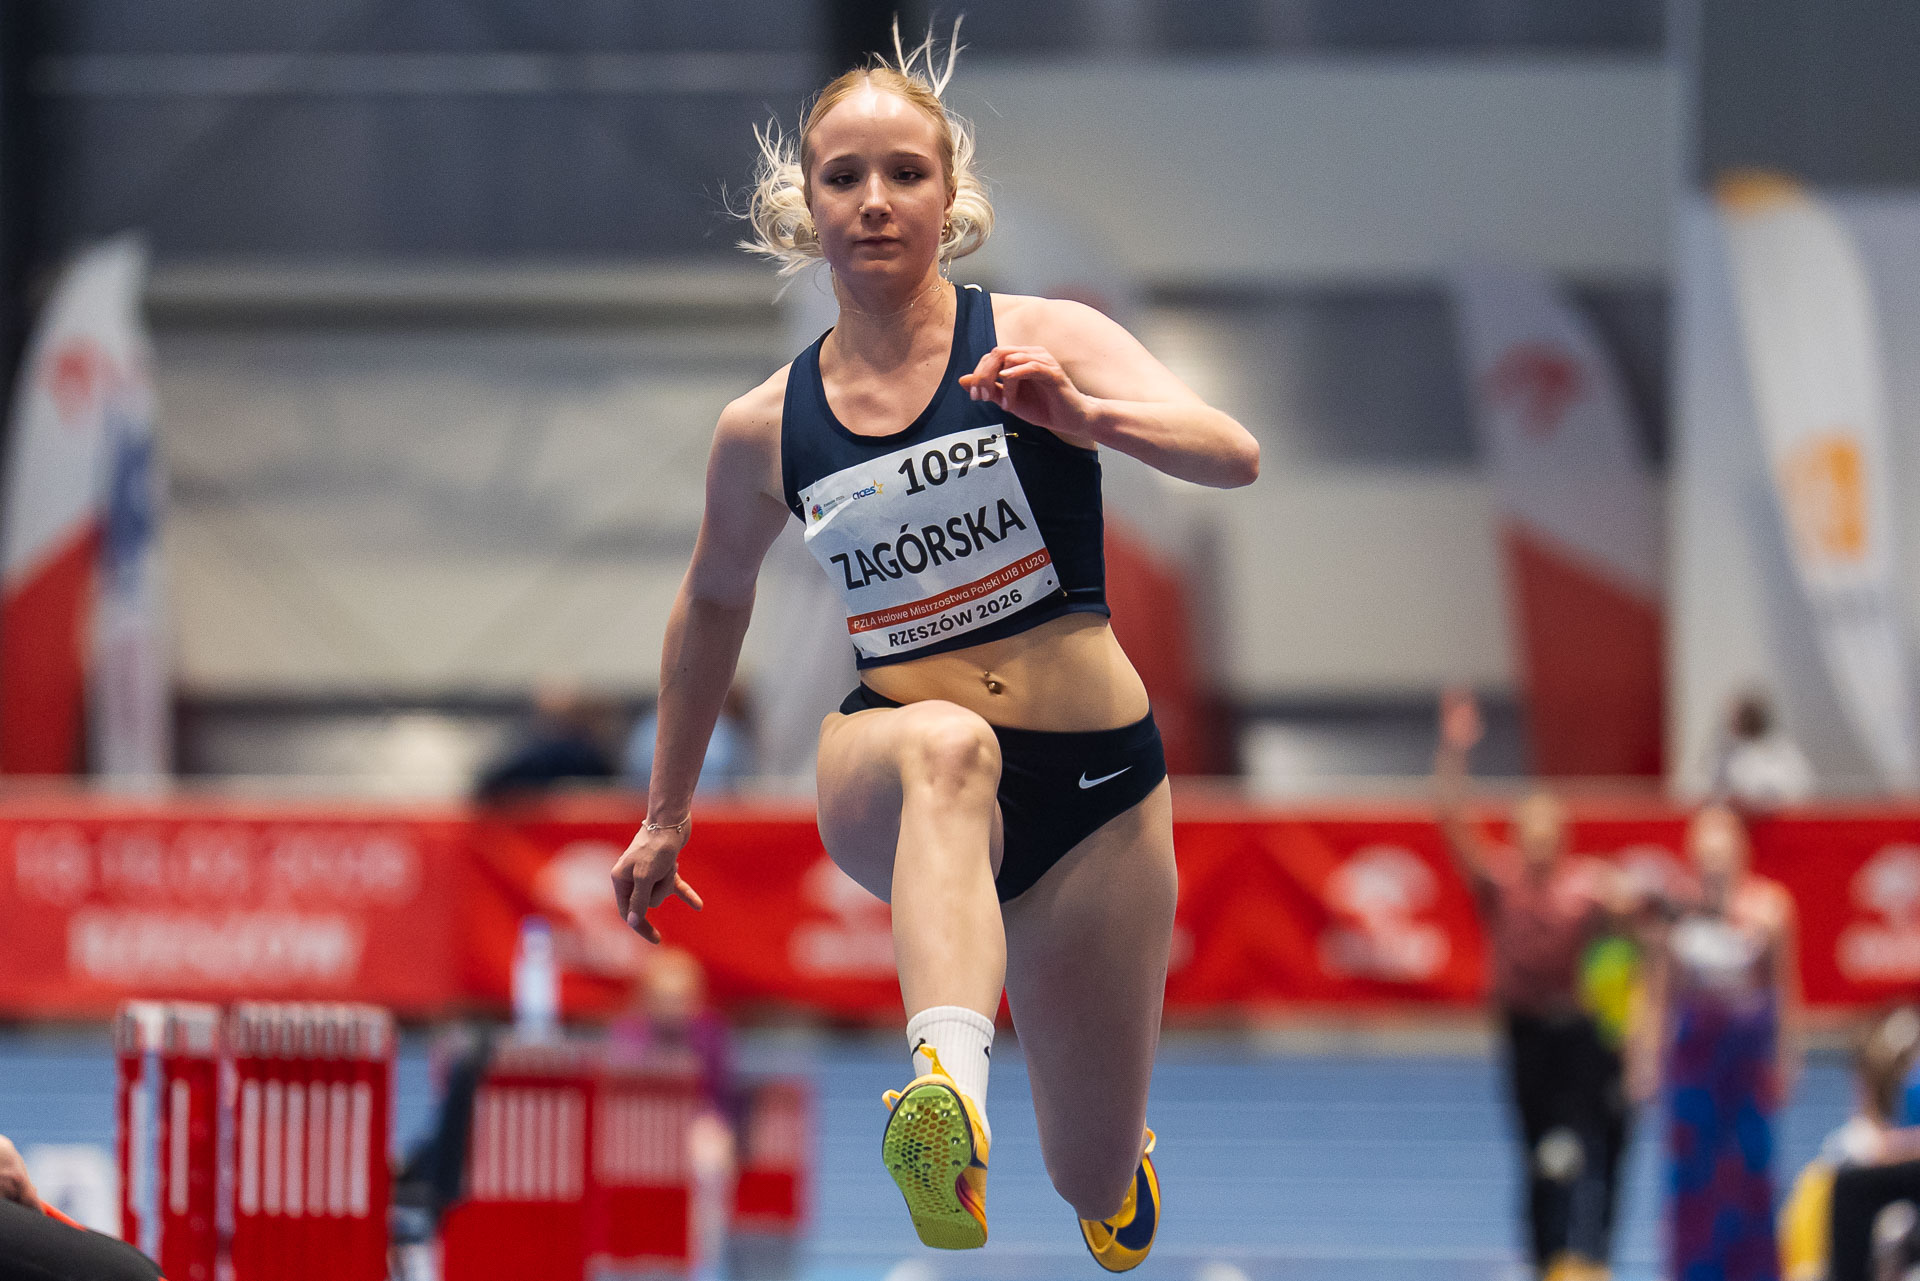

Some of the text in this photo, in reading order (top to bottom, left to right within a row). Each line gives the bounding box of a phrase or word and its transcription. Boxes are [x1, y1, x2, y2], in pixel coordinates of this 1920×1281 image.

[897, 438, 1001, 496] 1095
[829, 498, 1028, 590] ZAGÓRSKA
[853, 553, 1046, 630] PZLA Halowe Mistrzostwa Polski U18 i U20
[888, 588, 1023, 648] RZESZÓW 2026
